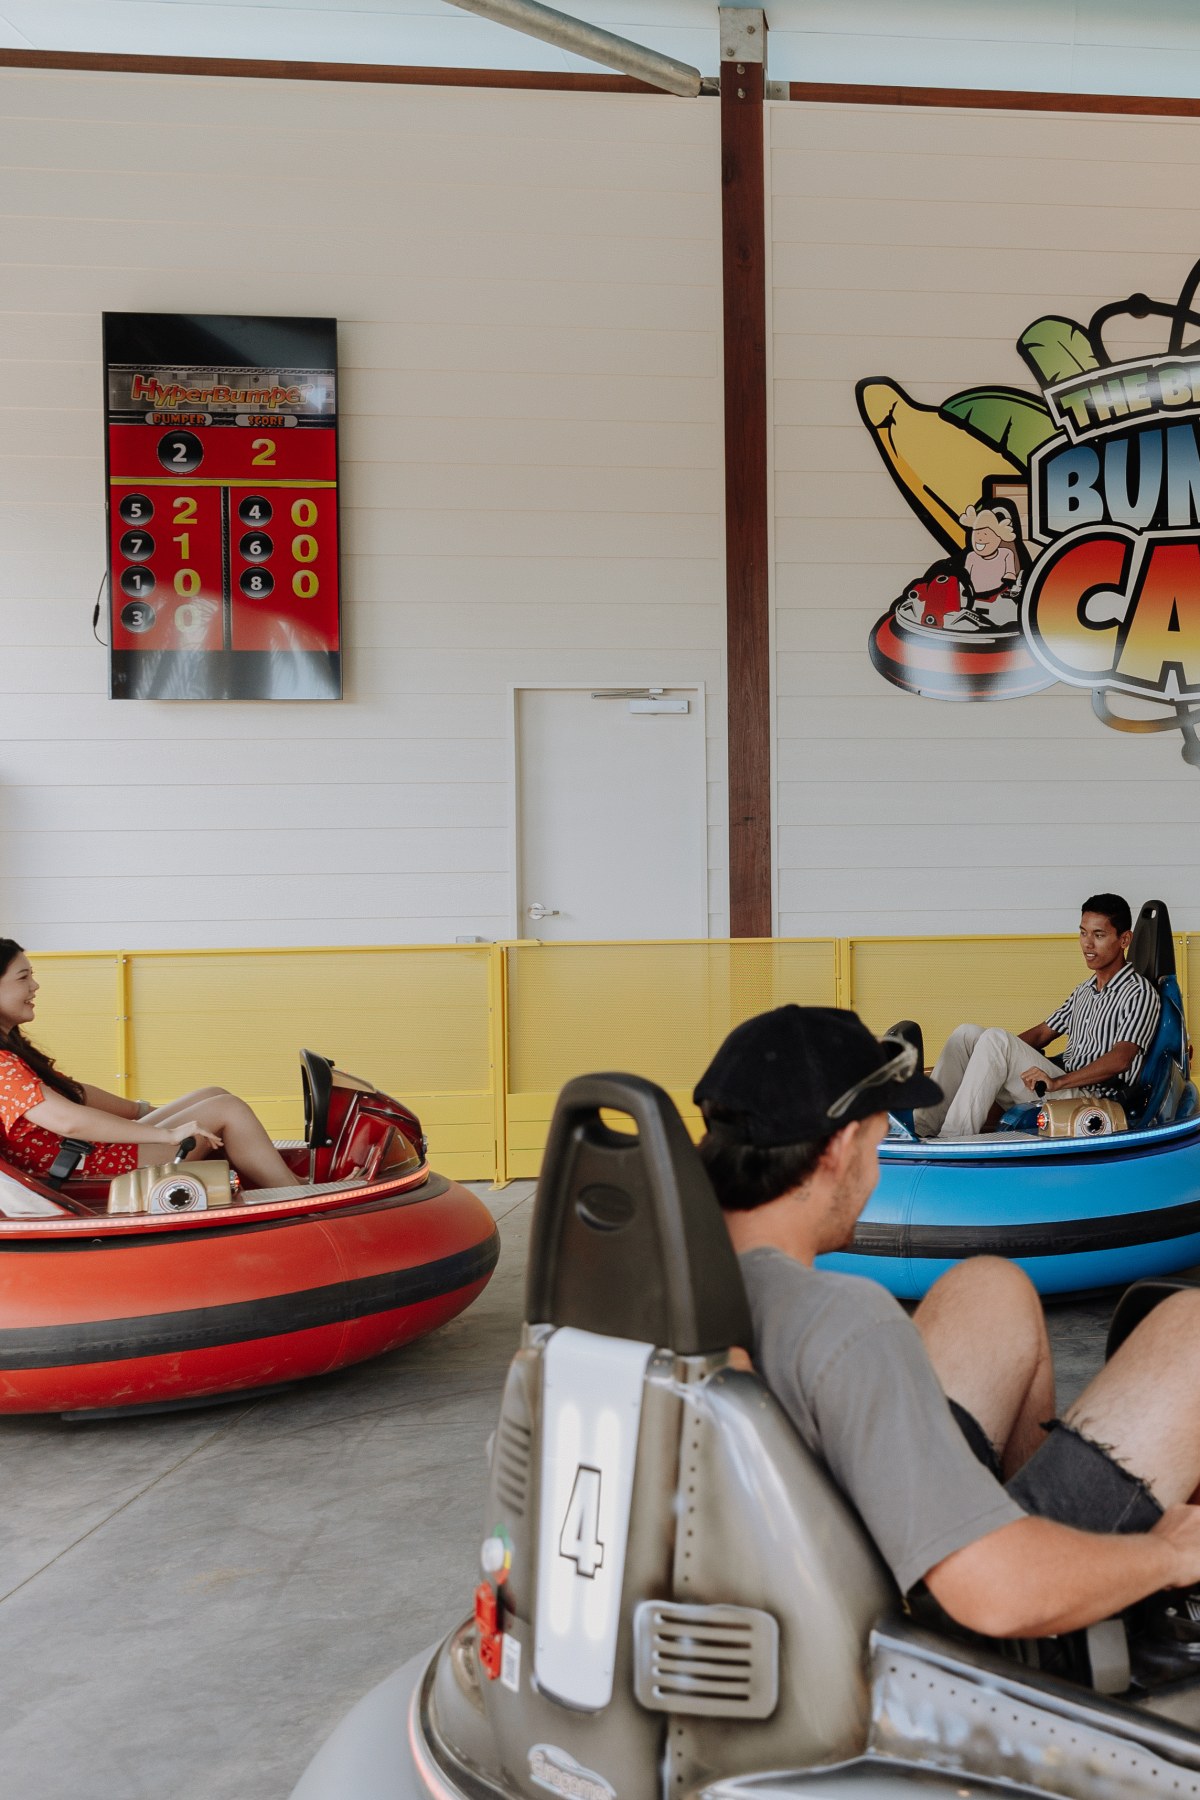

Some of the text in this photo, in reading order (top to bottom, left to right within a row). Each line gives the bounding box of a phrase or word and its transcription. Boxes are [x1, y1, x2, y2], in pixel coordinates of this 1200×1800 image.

[131, 374, 314, 410] HyperBumper
[1059, 373, 1152, 428] THE
[152, 413, 285, 427] BUMPER SCORE
[172, 438, 276, 466] 2 2
[131, 496, 198, 524] 5 2
[248, 498, 318, 527] 4 0
[131, 533, 190, 559] 7 1
[249, 534, 319, 563] 6 0
[132, 569, 201, 597] 1 0
[250, 570, 319, 599] 8 0
[132, 604, 201, 632] 3 0
[559, 1463, 604, 1580] 4
